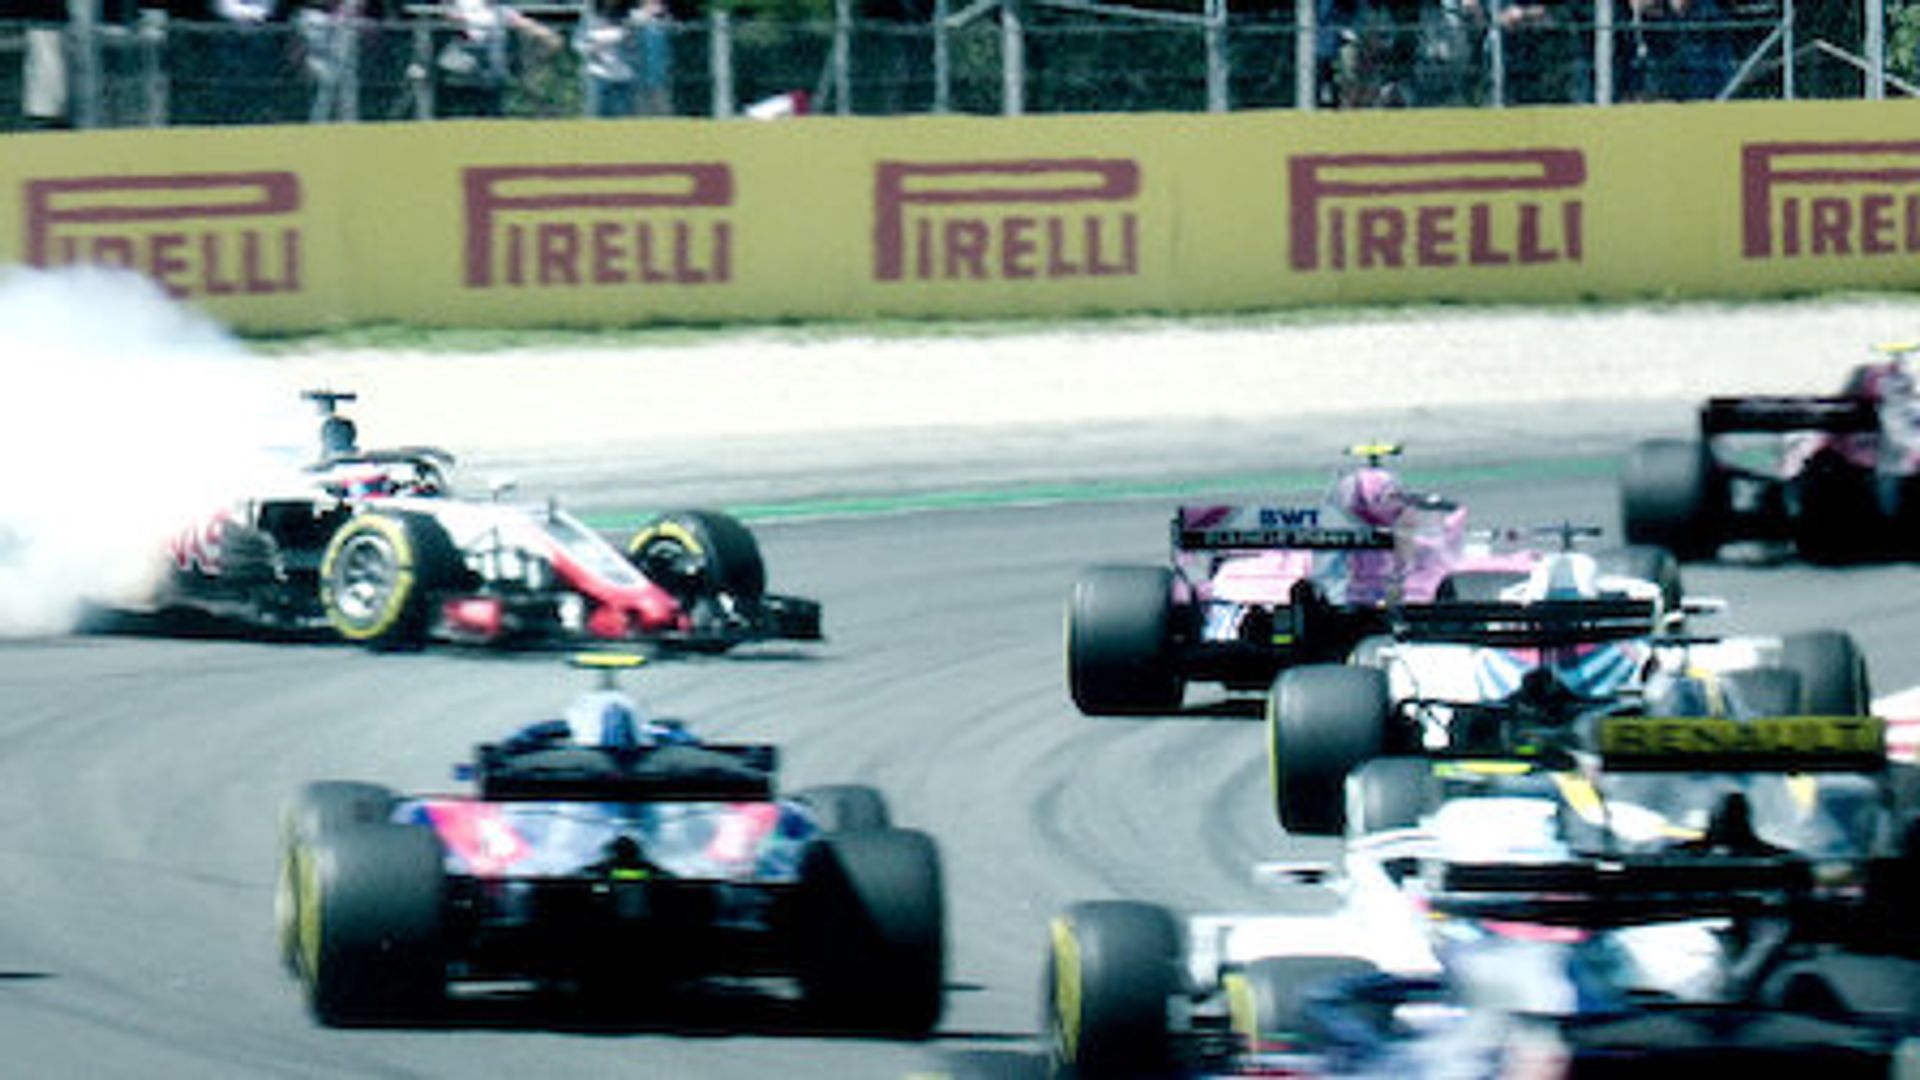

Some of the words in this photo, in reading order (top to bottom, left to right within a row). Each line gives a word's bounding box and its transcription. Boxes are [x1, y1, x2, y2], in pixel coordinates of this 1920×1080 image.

[462, 162, 736, 288] PIRELLI
[873, 158, 1140, 282] PIRELLI
[1286, 148, 1587, 272] PIRELLI
[1259, 508, 1317, 527] BWT
